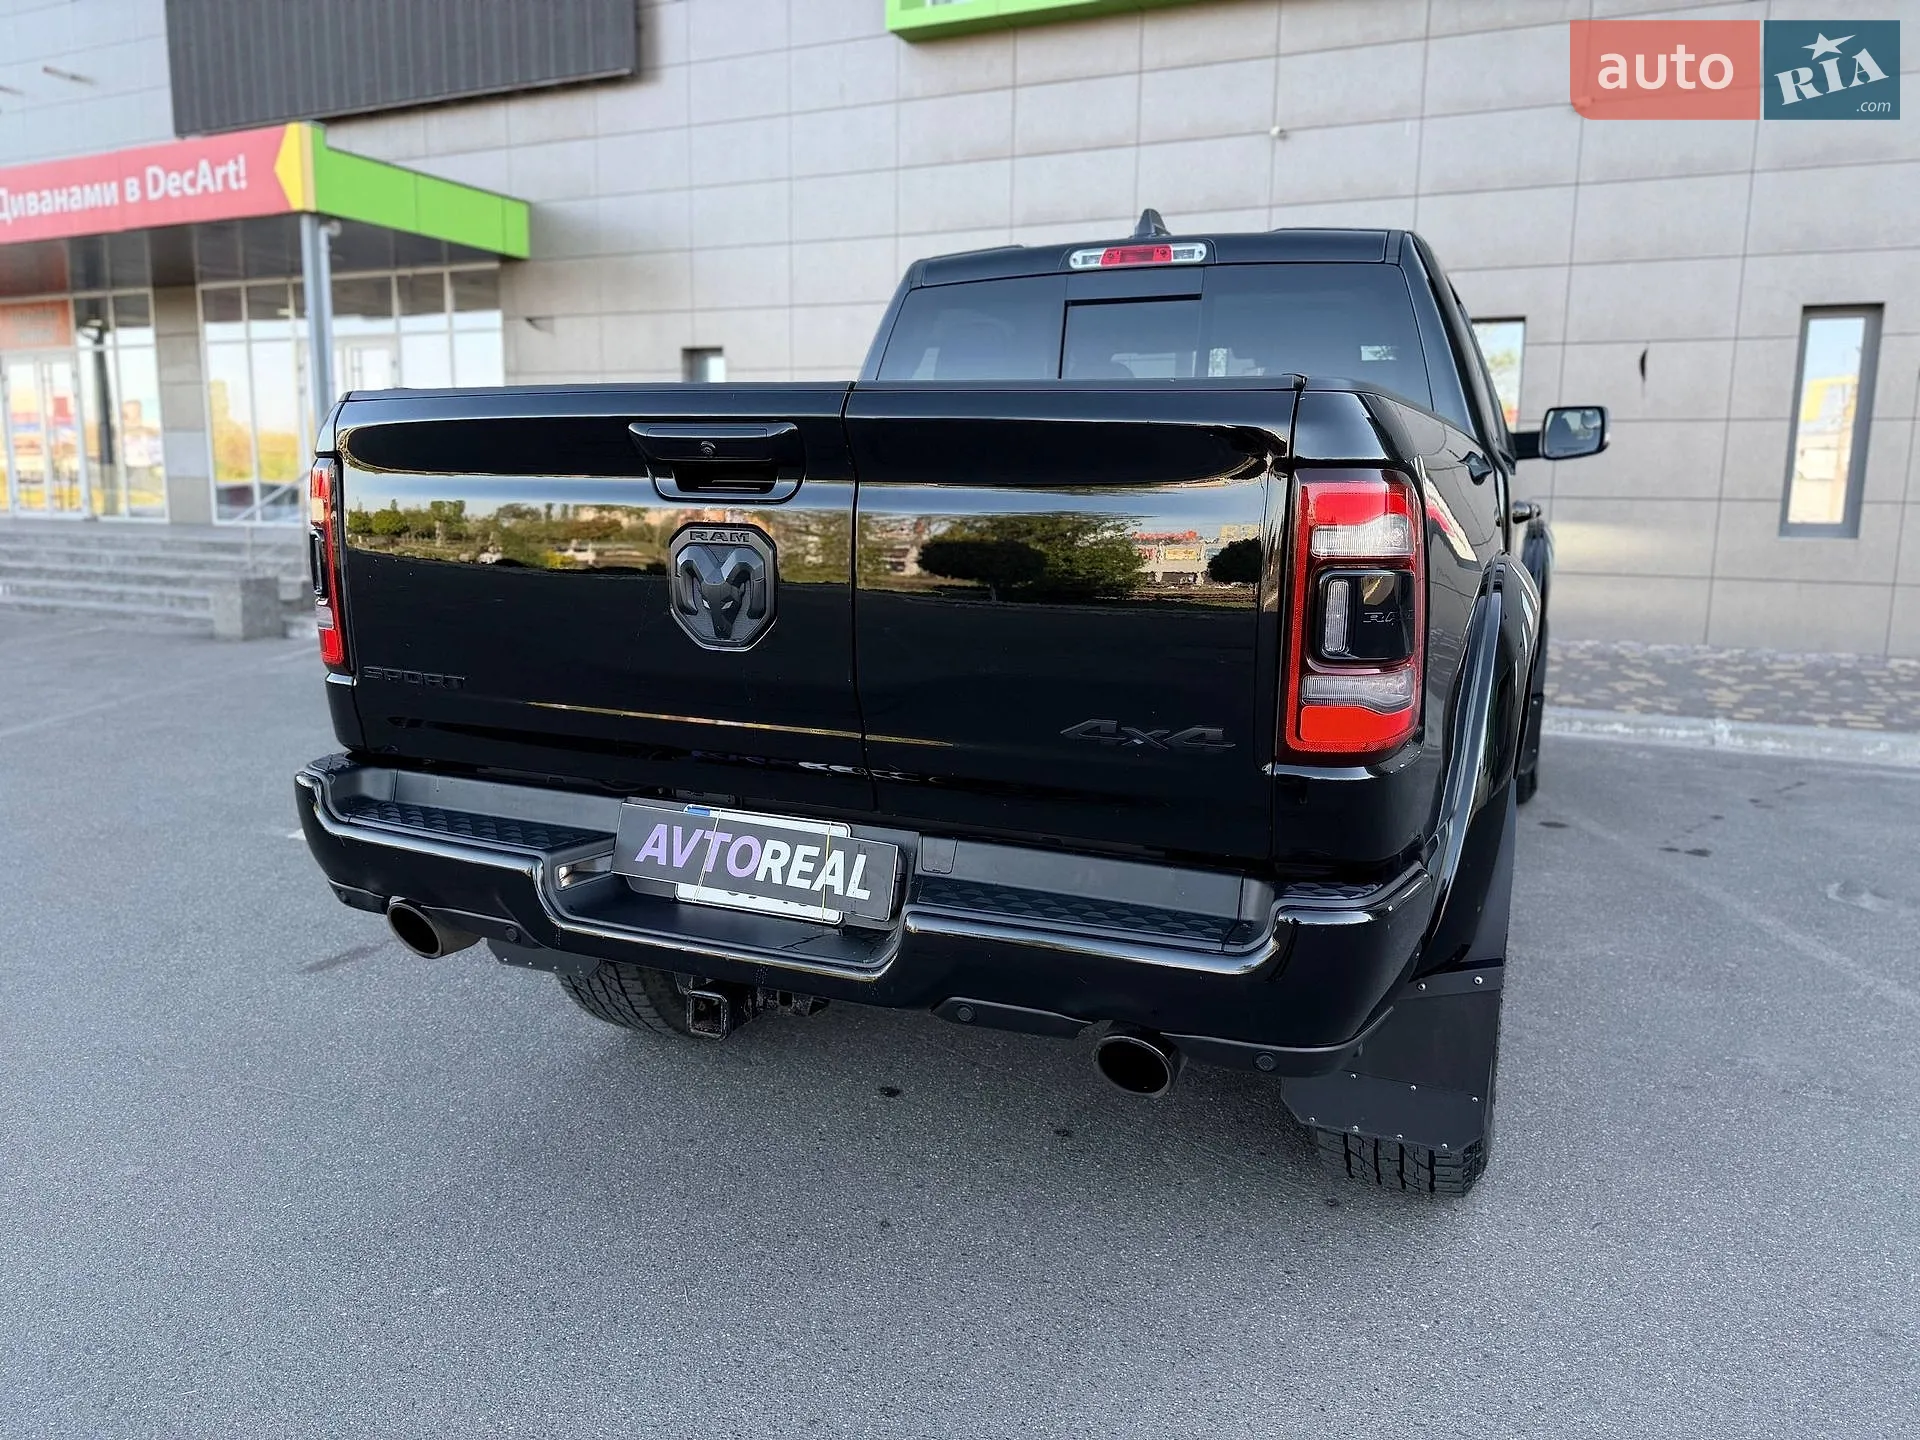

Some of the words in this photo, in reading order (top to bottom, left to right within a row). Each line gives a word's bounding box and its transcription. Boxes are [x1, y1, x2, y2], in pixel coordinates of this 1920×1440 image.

[145, 153, 248, 201] DecArt!
[689, 531, 750, 543] RAM
[363, 665, 466, 690] SPORT
[635, 823, 872, 901] AVTOREAL
